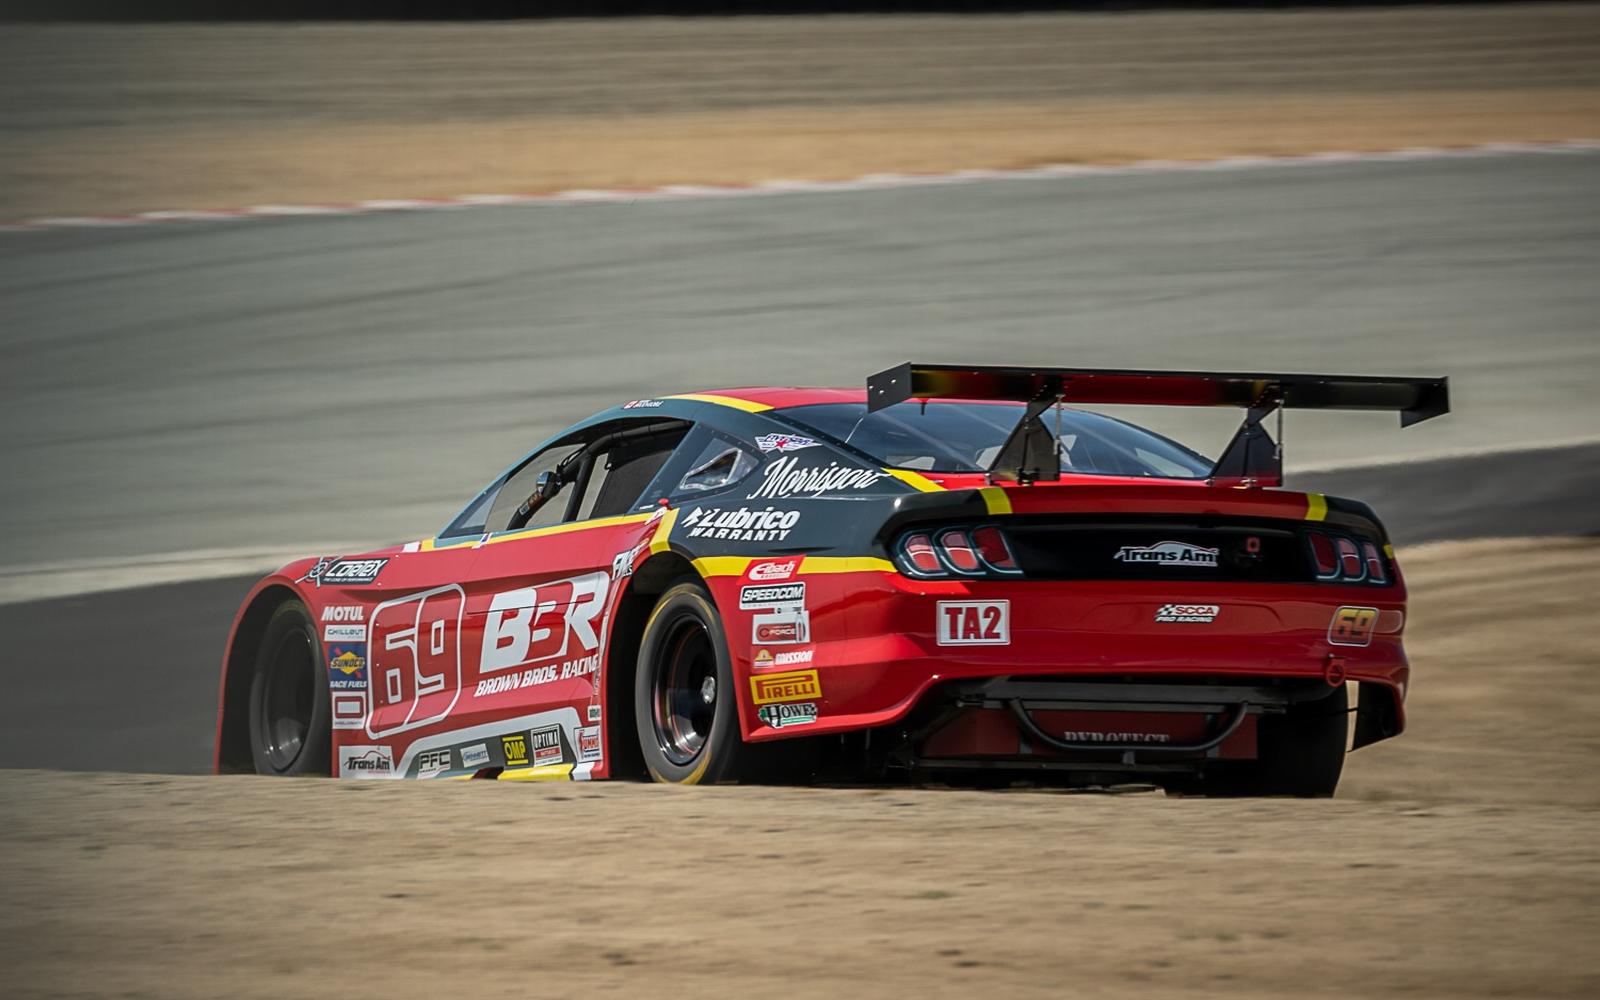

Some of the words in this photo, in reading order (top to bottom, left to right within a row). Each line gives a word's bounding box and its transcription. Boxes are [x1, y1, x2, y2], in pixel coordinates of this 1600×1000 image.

[699, 506, 800, 530] Lubrico
[686, 527, 791, 541] WARRANTY
[1120, 548, 1178, 561] Trans
[1179, 549, 1215, 562] Am
[742, 586, 804, 602] SPEEDCOM
[321, 606, 364, 621] MOTUL
[1175, 606, 1215, 615] SCCA
[944, 605, 1002, 640] TA2
[1331, 609, 1376, 642] 69
[331, 656, 366, 669] SUNOCO
[366, 583, 465, 739] 69
[348, 680, 367, 688] FUELS
[474, 671, 520, 698] BROWN
[521, 664, 558, 688] BROS.
[756, 674, 816, 700] PIRELLI
[533, 730, 559, 749] OPTIMA
[504, 741, 526, 760] OMP
[348, 757, 375, 770] Trans
[375, 757, 390, 770] Am
[420, 751, 450, 769] PFC
